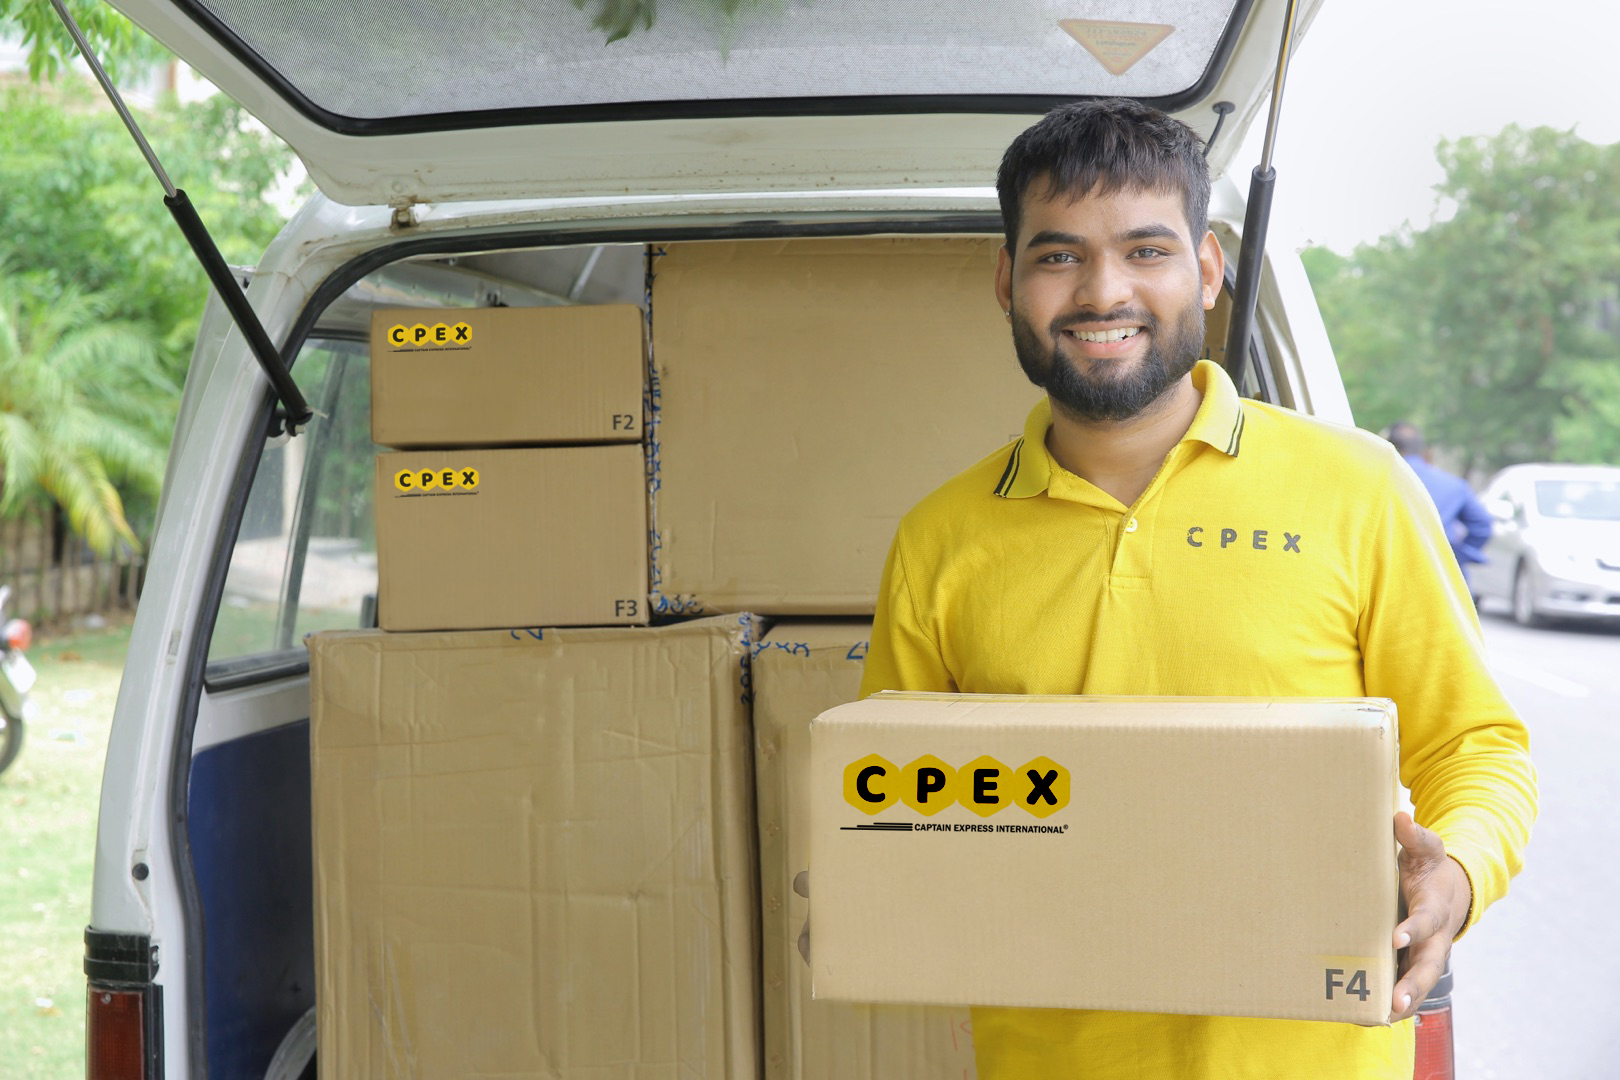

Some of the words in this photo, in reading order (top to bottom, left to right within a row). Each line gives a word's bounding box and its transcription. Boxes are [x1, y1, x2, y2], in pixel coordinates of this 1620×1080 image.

[393, 327, 467, 342] CPEX
[612, 414, 635, 431] F2
[400, 472, 474, 487] CPEX
[1187, 526, 1301, 553] CPEX
[615, 599, 638, 617] F3
[856, 765, 1059, 806] CPEX
[914, 823, 951, 832] CAPTAIN
[953, 823, 994, 833] EXPRESS
[1325, 968, 1371, 1002] F4
